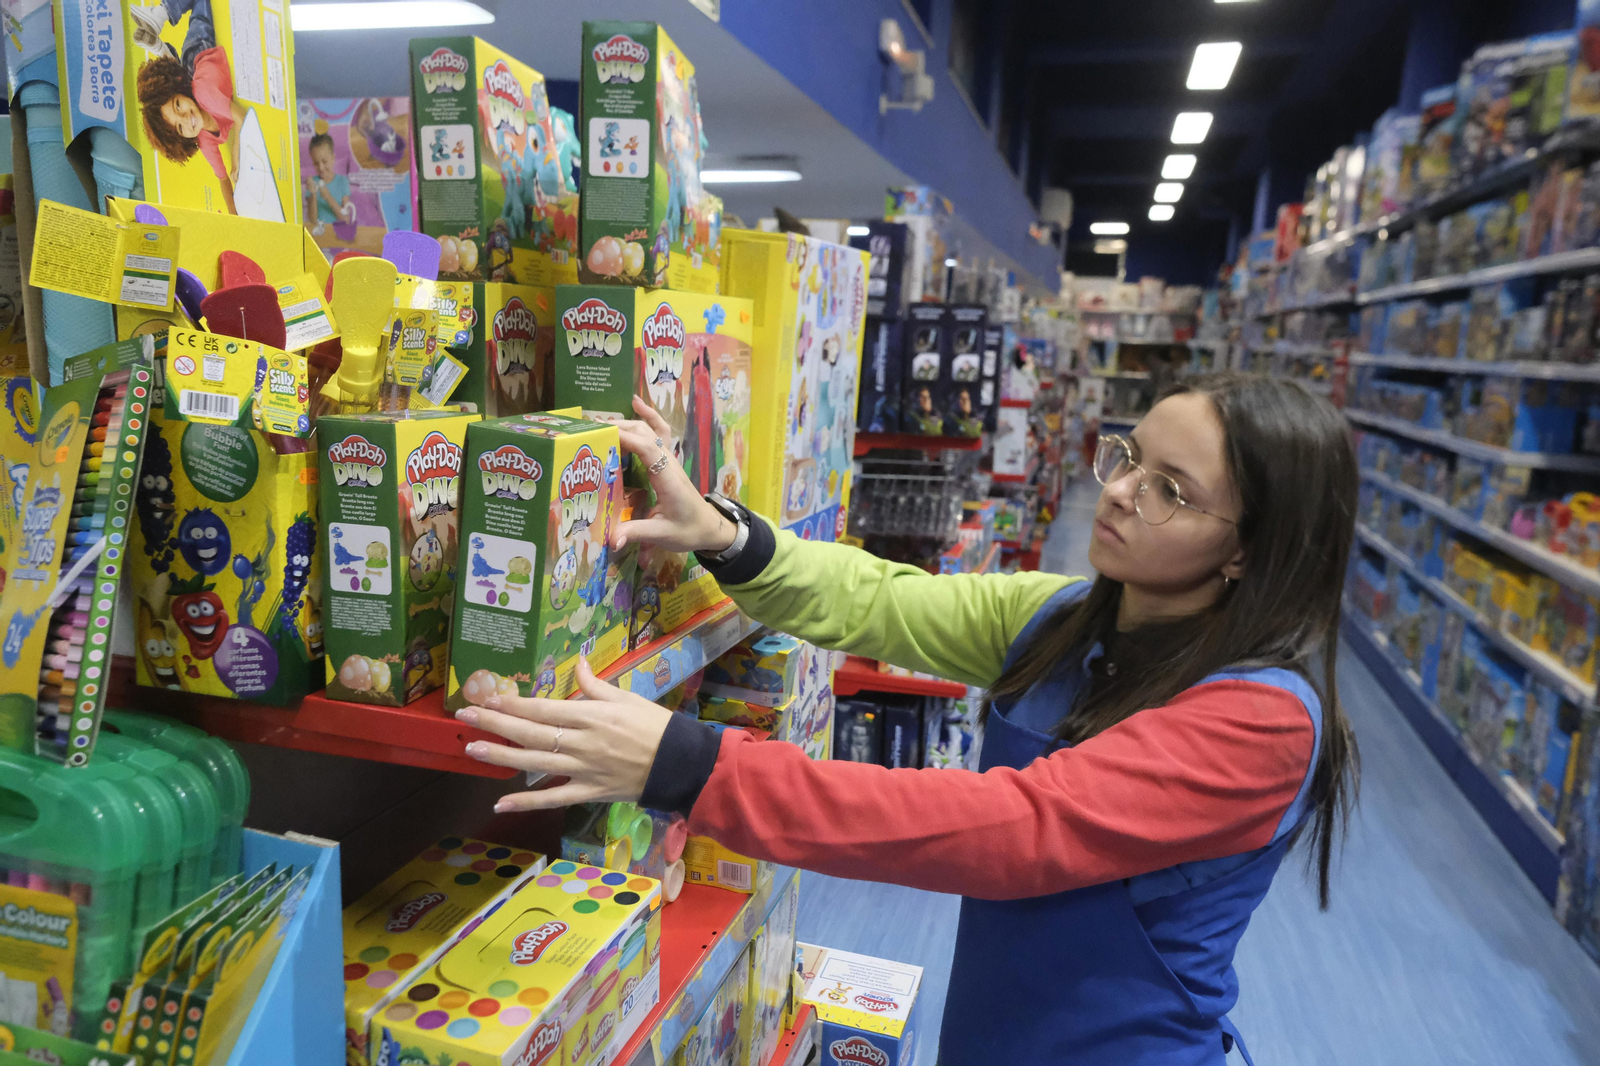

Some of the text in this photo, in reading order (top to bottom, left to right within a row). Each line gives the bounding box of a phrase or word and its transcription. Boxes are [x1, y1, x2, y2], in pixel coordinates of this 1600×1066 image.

[87, 54, 96, 63] y
[594, 41, 647, 62] Play-Doh
[96, 25, 117, 110] Tapete
[596, 60, 645, 84] DINO
[89, 65, 101, 104] Borra
[423, 72, 467, 94] DINO
[495, 309, 535, 337] Play-Doh
[564, 306, 623, 331] Play-Doh
[644, 315, 683, 346] Play-Doh
[176, 332, 197, 348] CE
[204, 336, 219, 345] UK
[402, 340, 425, 349] scents
[403, 328, 425, 342] Silly
[566, 329, 623, 357] DINO
[497, 339, 536, 376] DINO
[645, 345, 684, 385] DINO
[65, 365, 74, 382] 24
[269, 368, 295, 386] Silly
[270, 384, 296, 395] scents
[204, 427, 243, 451] Bubble
[220, 426, 239, 439] Blast
[239, 434, 249, 443] of
[213, 441, 230, 453] Fun!
[329, 441, 383, 464] Play-Doh
[408, 443, 462, 481] Play-Doh
[479, 451, 539, 479] Play-Doh
[332, 462, 383, 487] DINO
[481, 470, 537, 501] DINO
[561, 456, 601, 496] Play-Doh
[561, 489, 599, 539] DINO
[7, 622, 23, 653] 24
[232, 627, 250, 647] 4
[235, 683, 266, 693] profumi
[4, 902, 71, 932] Colour
[388, 893, 441, 931] Play-Doh
[512, 922, 564, 964] Play-Doh
[624, 994, 634, 1016] 20
[855, 996, 898, 1012] Play-Doh
[832, 1042, 886, 1064] Play-Doh
